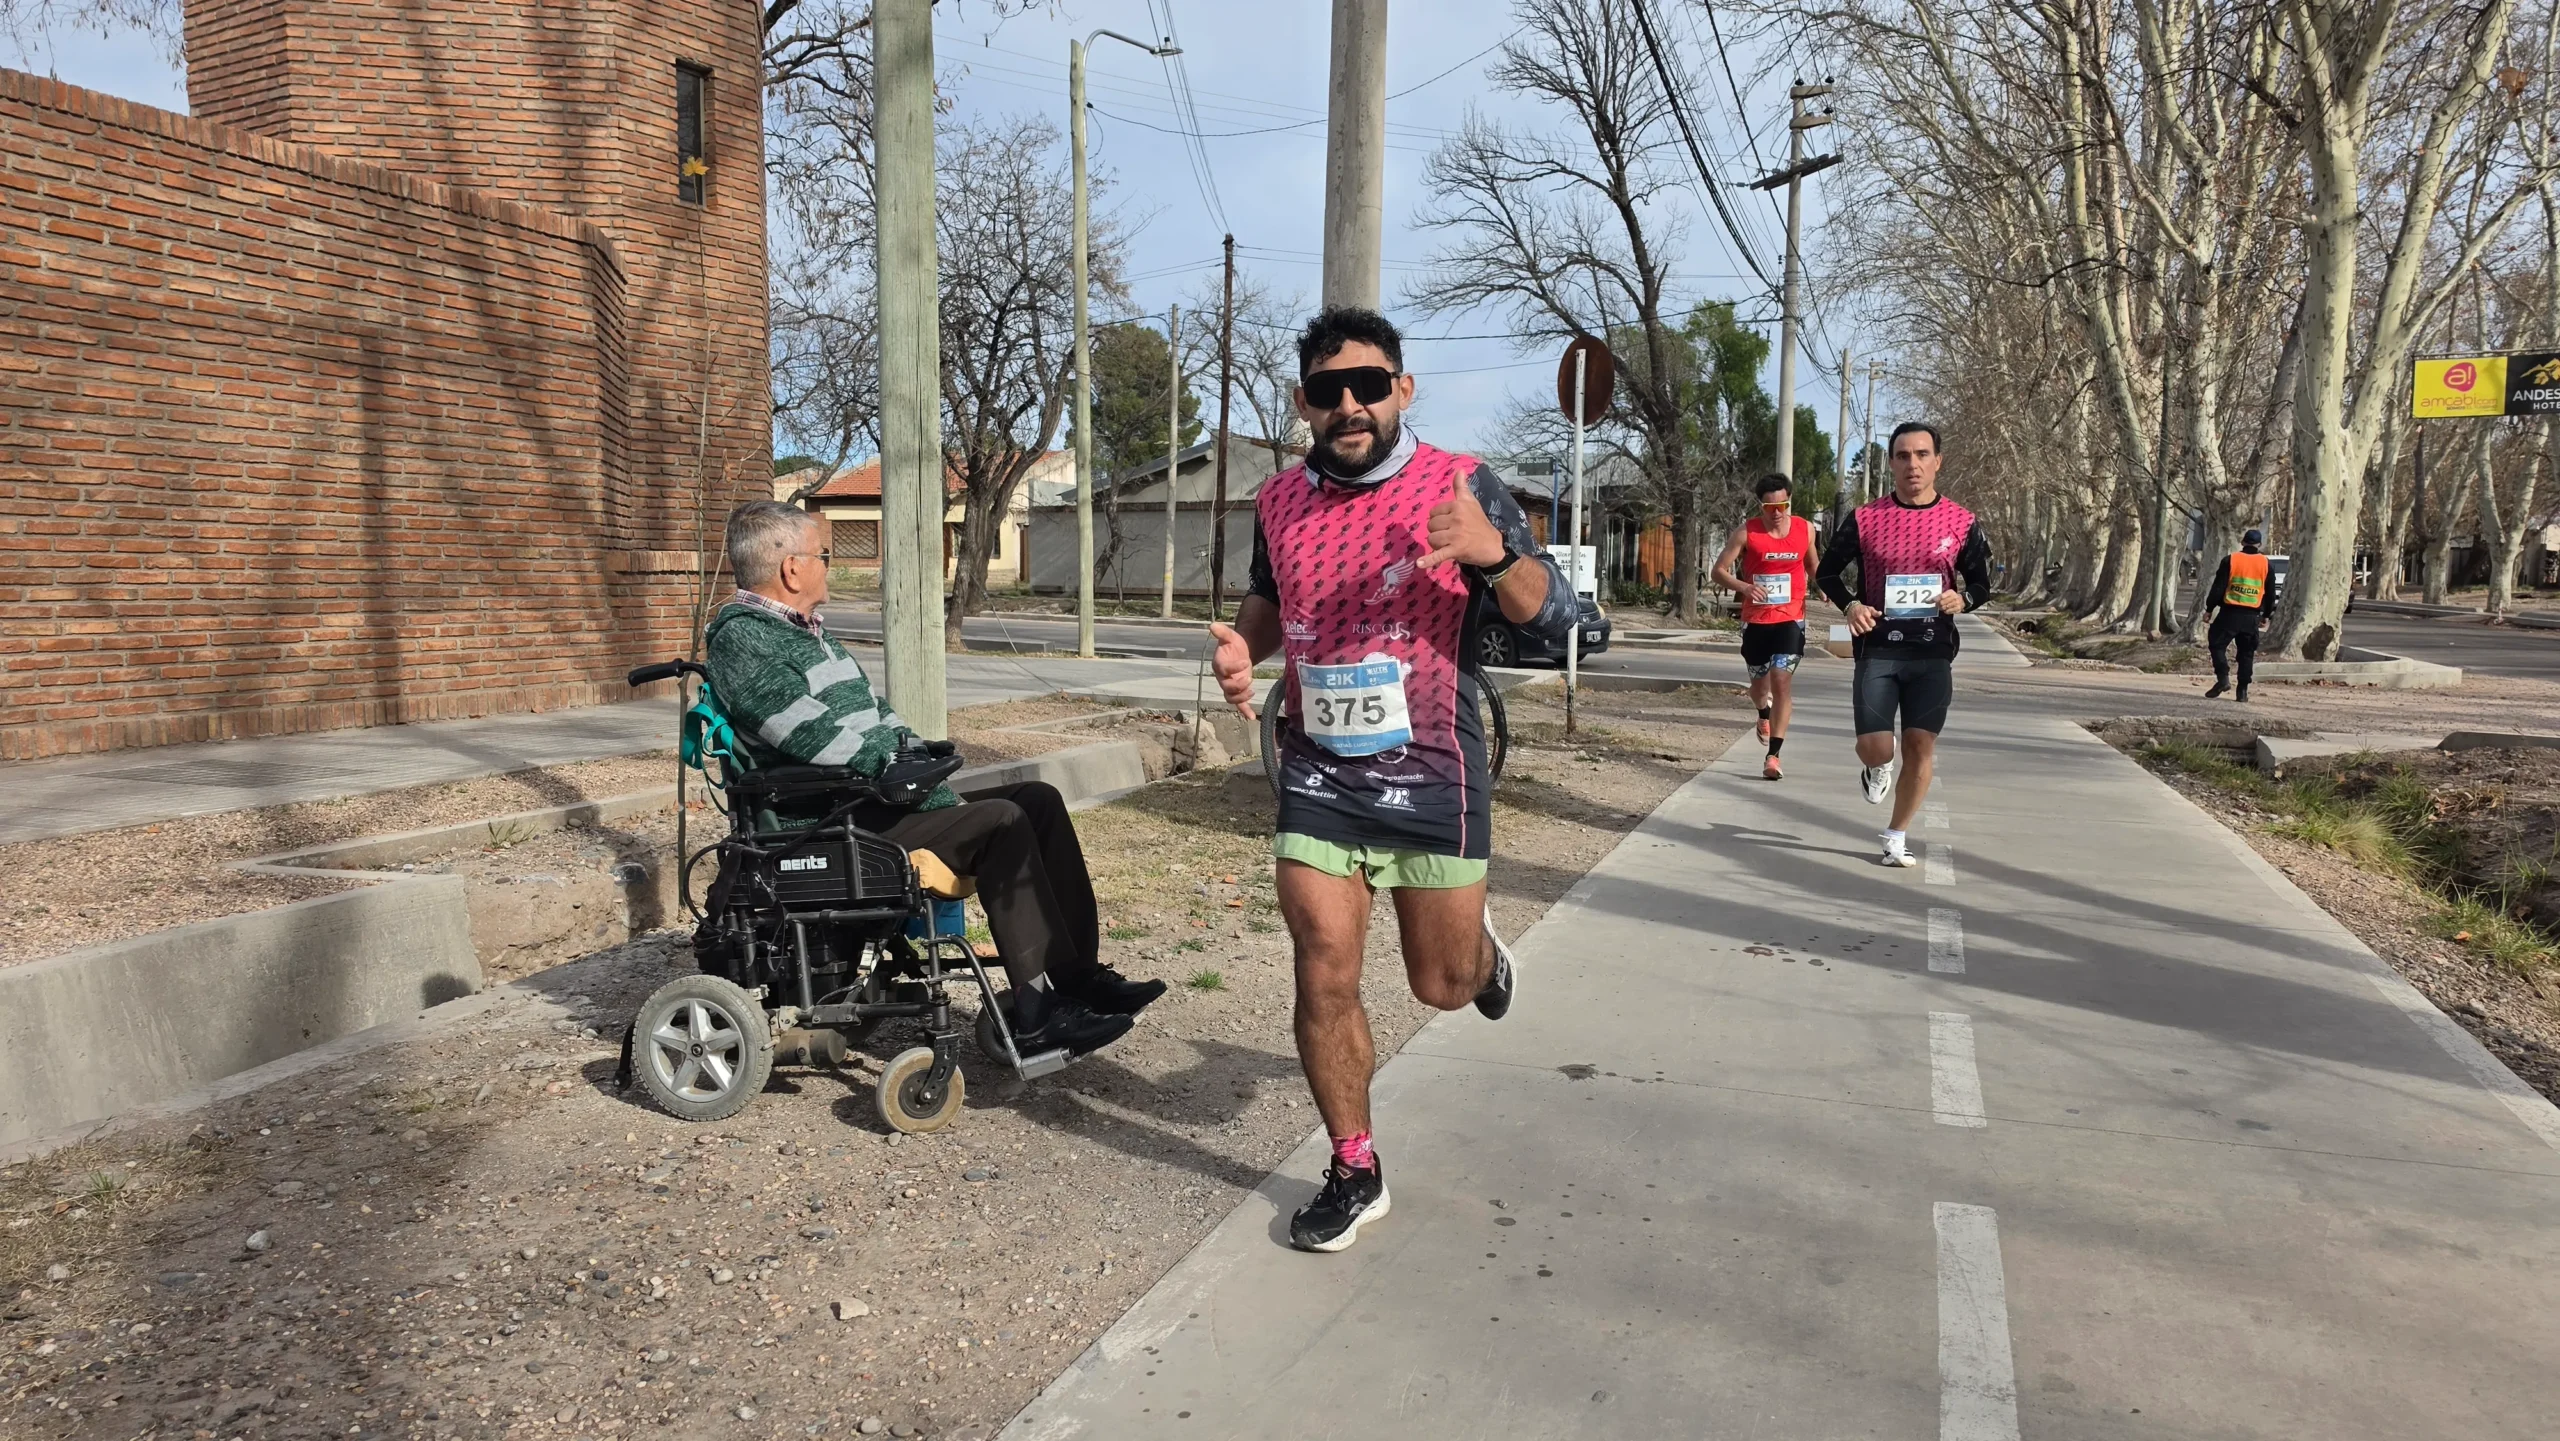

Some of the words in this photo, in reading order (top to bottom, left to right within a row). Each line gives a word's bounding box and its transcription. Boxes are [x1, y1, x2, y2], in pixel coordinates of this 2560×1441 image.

[2512, 388, 2560, 401] ANDES
[1906, 577, 1922, 585] 21K
[1762, 584, 1782, 595] 21
[2230, 584, 2259, 595] POLICIA
[1895, 589, 1934, 605] 212
[1352, 623, 1393, 635] RISCO
[1326, 672, 1356, 687] 21K
[1314, 694, 1387, 727] 375
[1308, 789, 1338, 799] Buttini
[780, 855, 828, 871] merits
